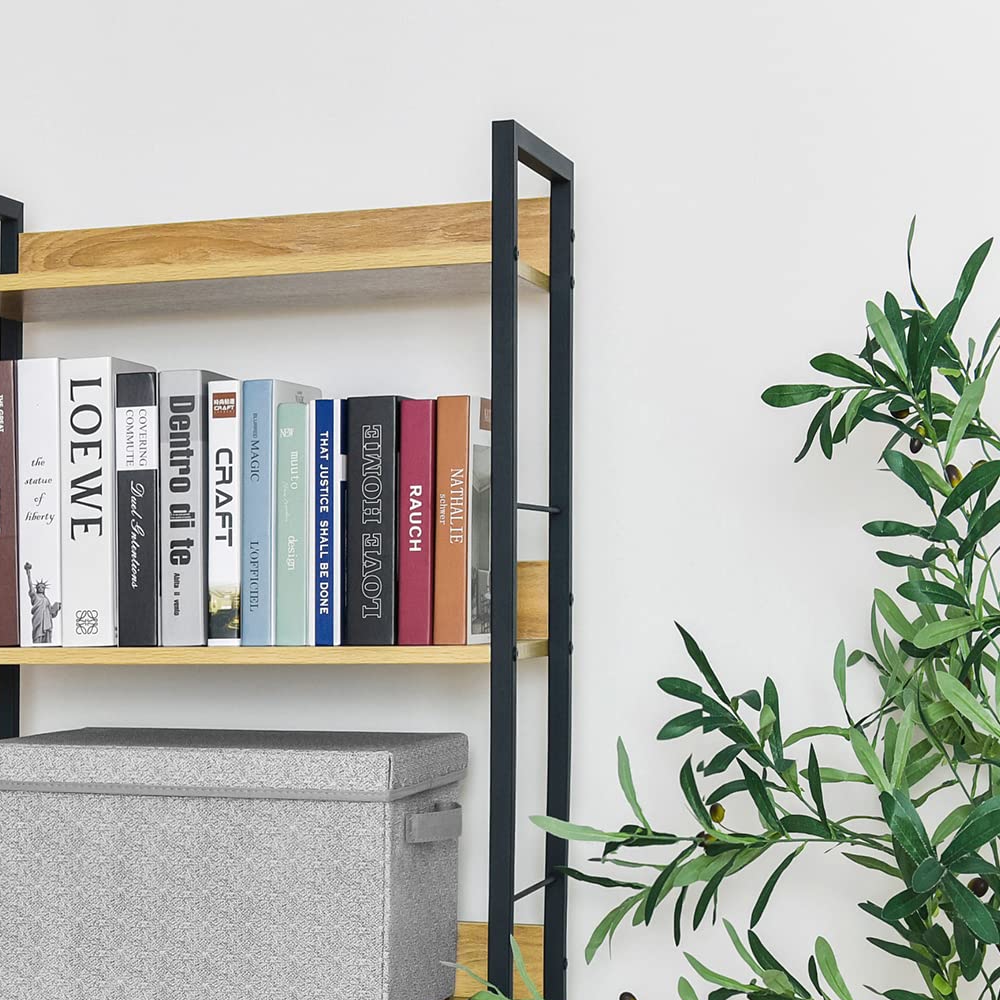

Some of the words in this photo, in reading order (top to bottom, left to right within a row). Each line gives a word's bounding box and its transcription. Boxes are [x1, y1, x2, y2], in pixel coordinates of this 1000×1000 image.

[126, 410, 135, 466] COMMUTE
[138, 409, 147, 467] COVERING
[169, 395, 195, 493] Dentro
[320, 431, 329, 460] THAT
[31, 457, 45, 467] the
[70, 378, 102, 541] LOEWE
[250, 440, 260, 482] MAGIC
[290, 451, 299, 490] muuto
[362, 425, 382, 524] HOME
[24, 476, 52, 485] statue
[34, 493, 45, 506] of
[215, 448, 233, 547] CRAFT
[320, 462, 329, 513] JUSTICE
[25, 511, 55, 525] liberty
[170, 503, 195, 528] di
[409, 485, 422, 552] RAUCH
[449, 468, 464, 544] NATHALIE
[170, 538, 195, 565] te
[286, 535, 298, 570] design
[320, 520, 329, 559] SHALL
[320, 563, 329, 578] BE
[362, 533, 382, 618] LOVE
[320, 581, 329, 615] DONE
